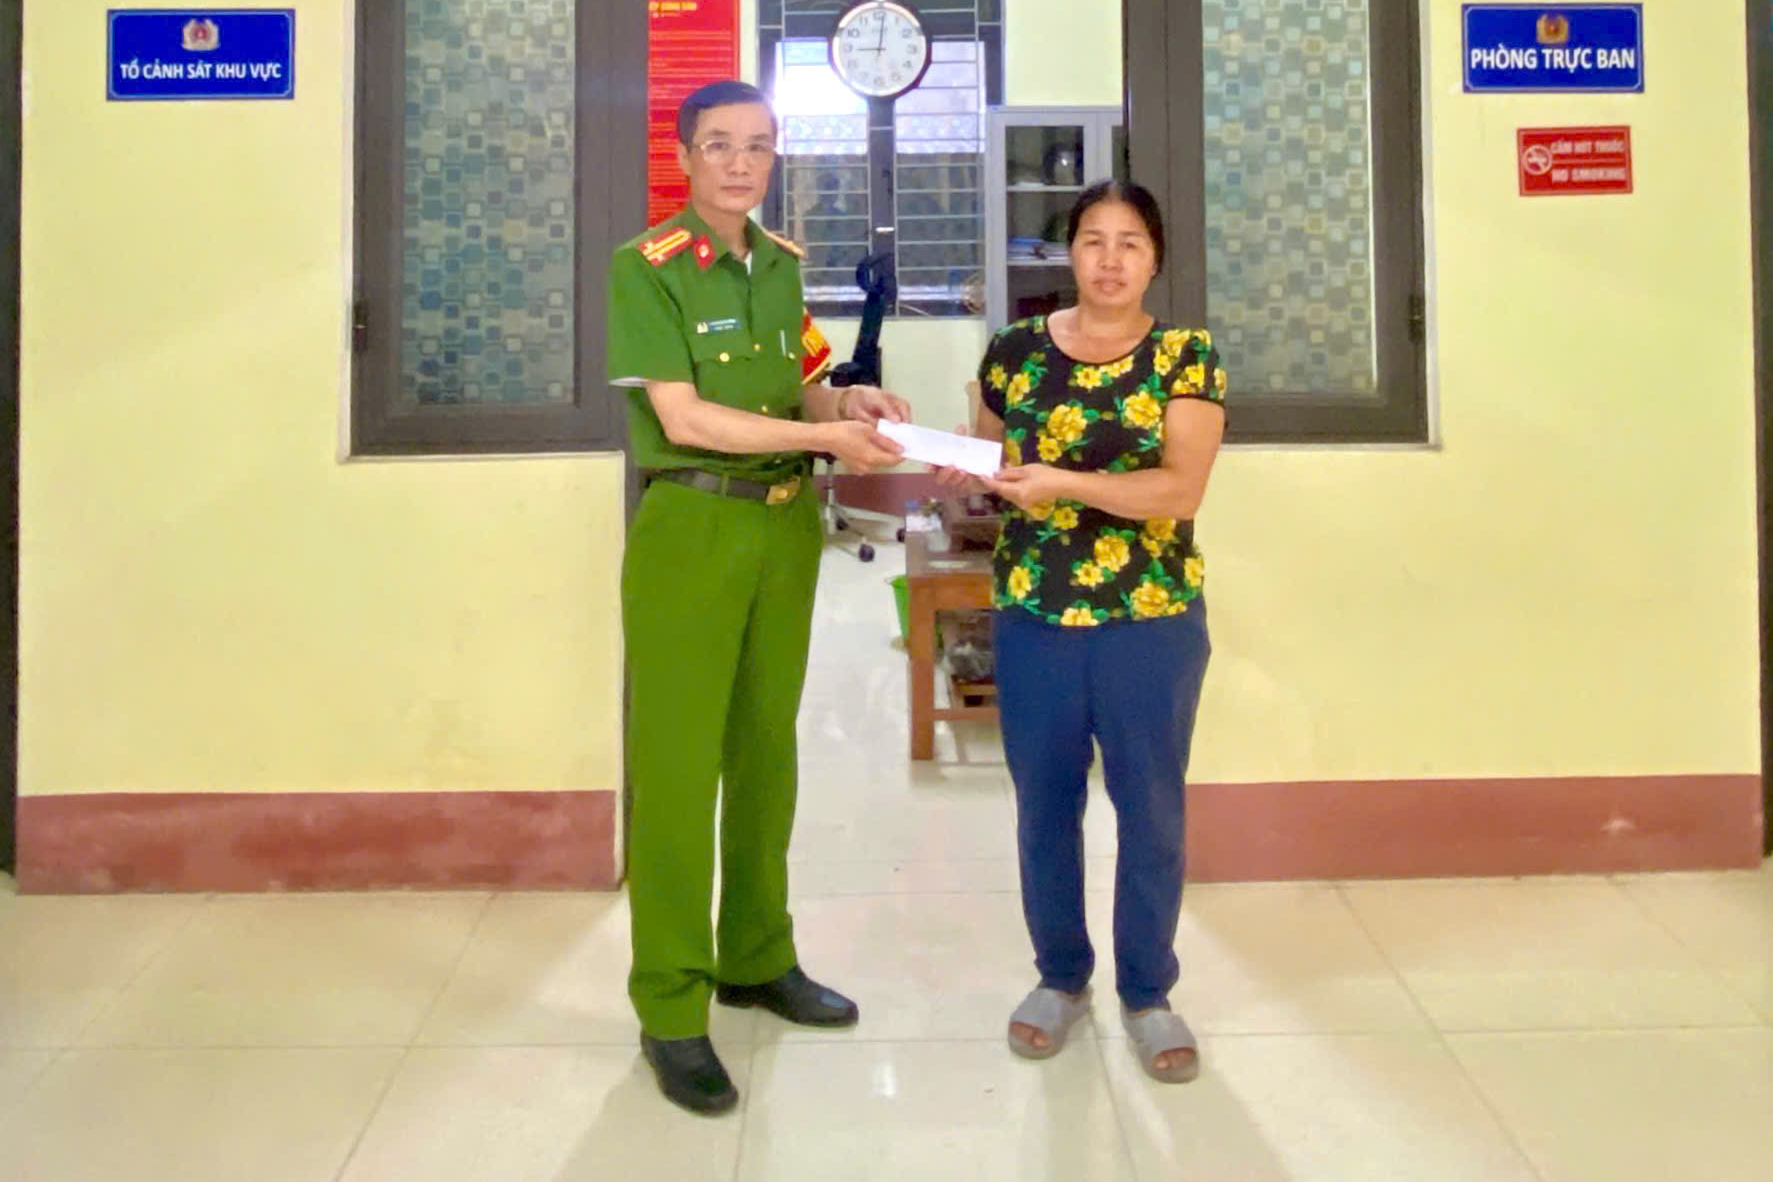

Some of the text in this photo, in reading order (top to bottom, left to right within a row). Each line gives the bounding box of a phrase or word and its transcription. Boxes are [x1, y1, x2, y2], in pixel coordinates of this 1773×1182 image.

[143, 57, 184, 79] CẢNH
[187, 59, 213, 79] SÁT
[215, 63, 247, 79] KHU
[250, 61, 282, 83] VỰC
[1471, 42, 1635, 74] PHÒNG TRỰC BAN
